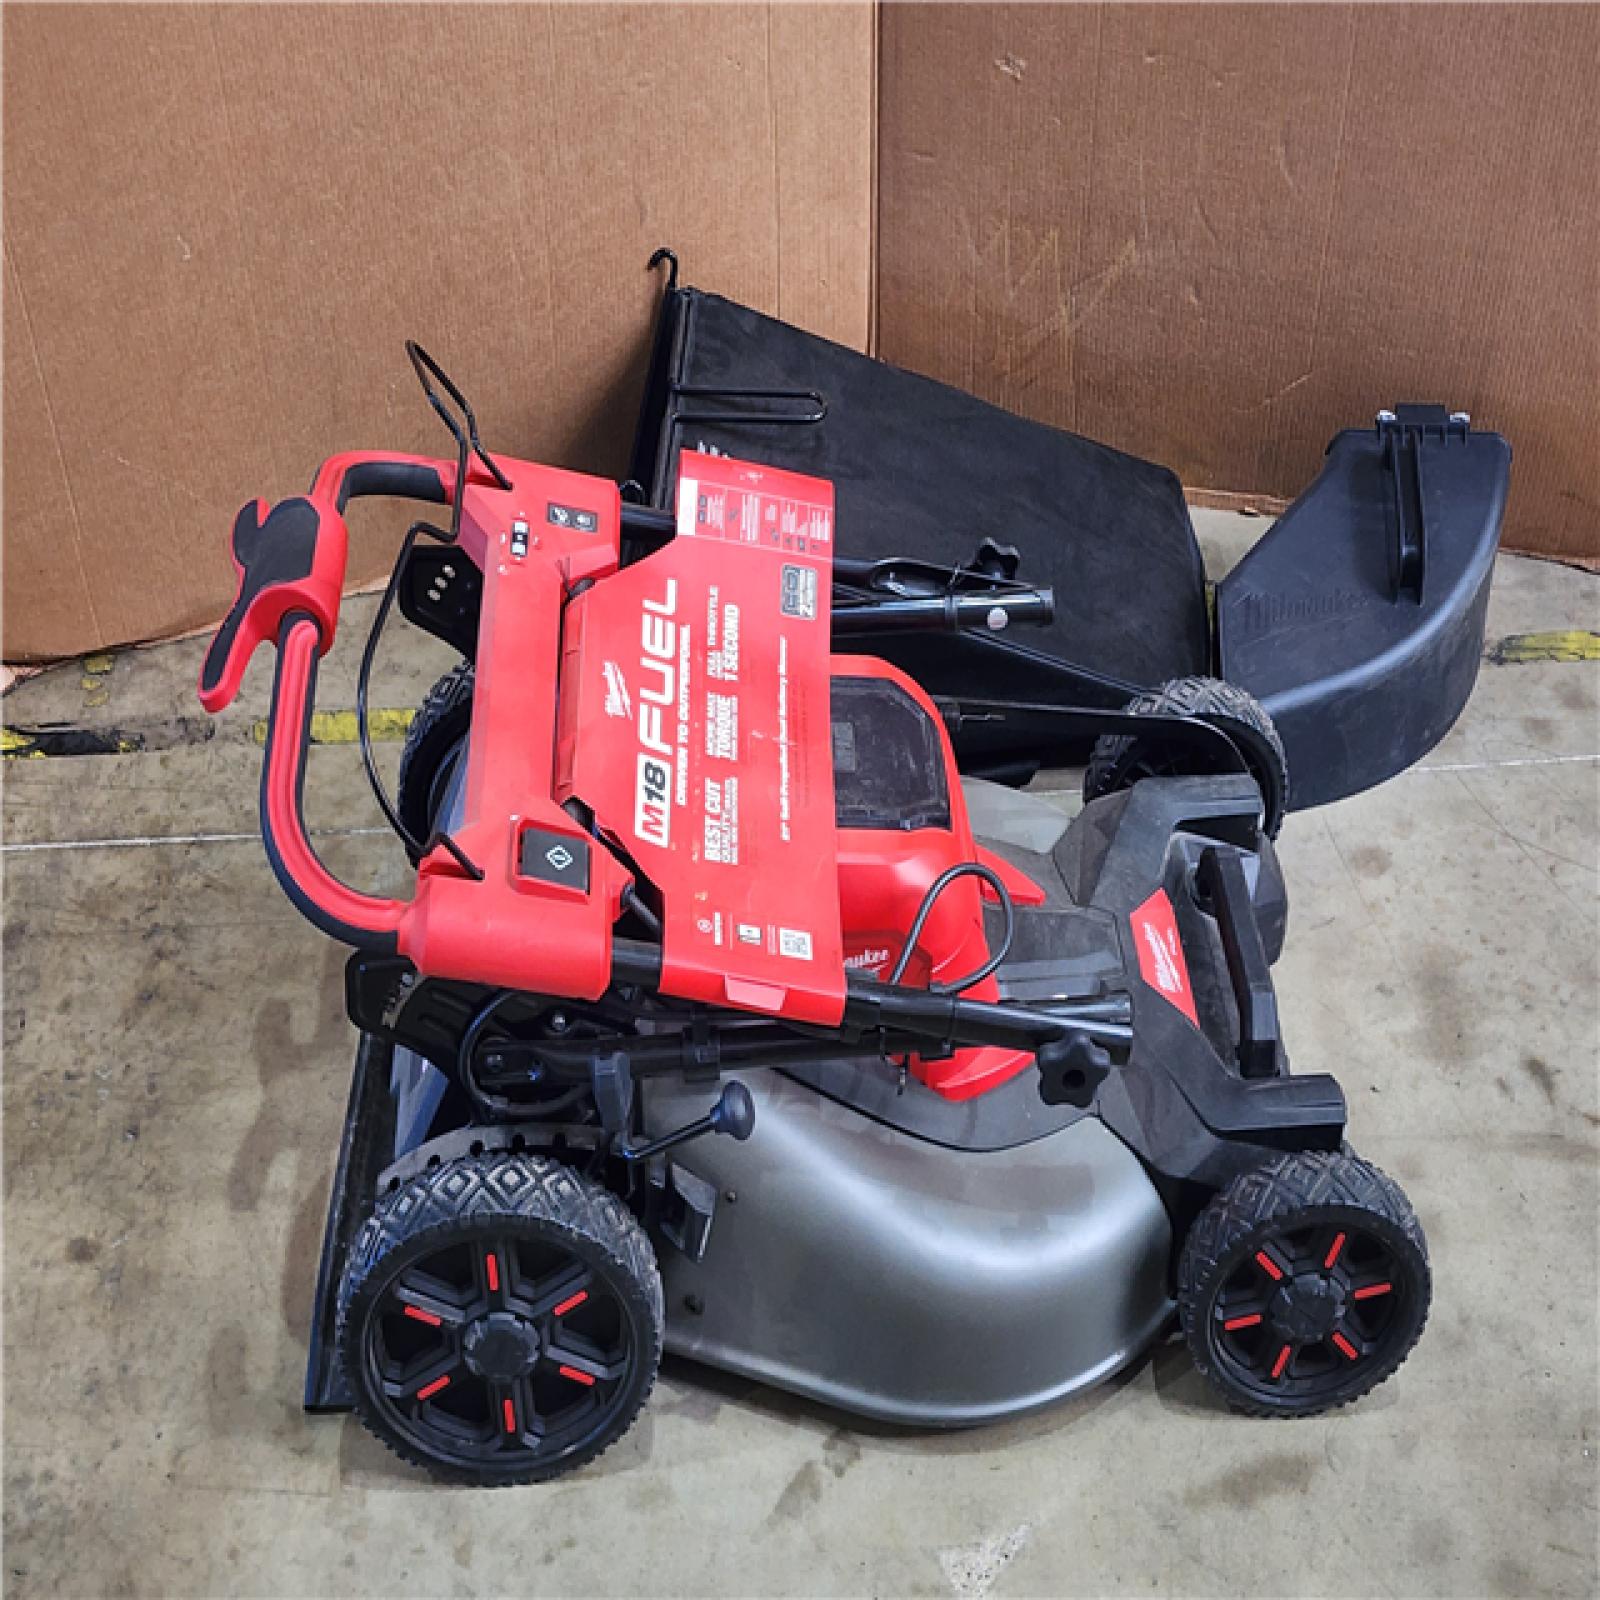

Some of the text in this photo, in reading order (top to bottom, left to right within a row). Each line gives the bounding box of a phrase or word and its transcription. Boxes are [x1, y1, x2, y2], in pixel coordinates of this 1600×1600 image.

[723, 604, 738, 671] SECOND
[638, 577, 677, 843] M18 FUEL
[716, 694, 731, 757] TORQUE
[703, 776, 721, 861] BEST CUT
